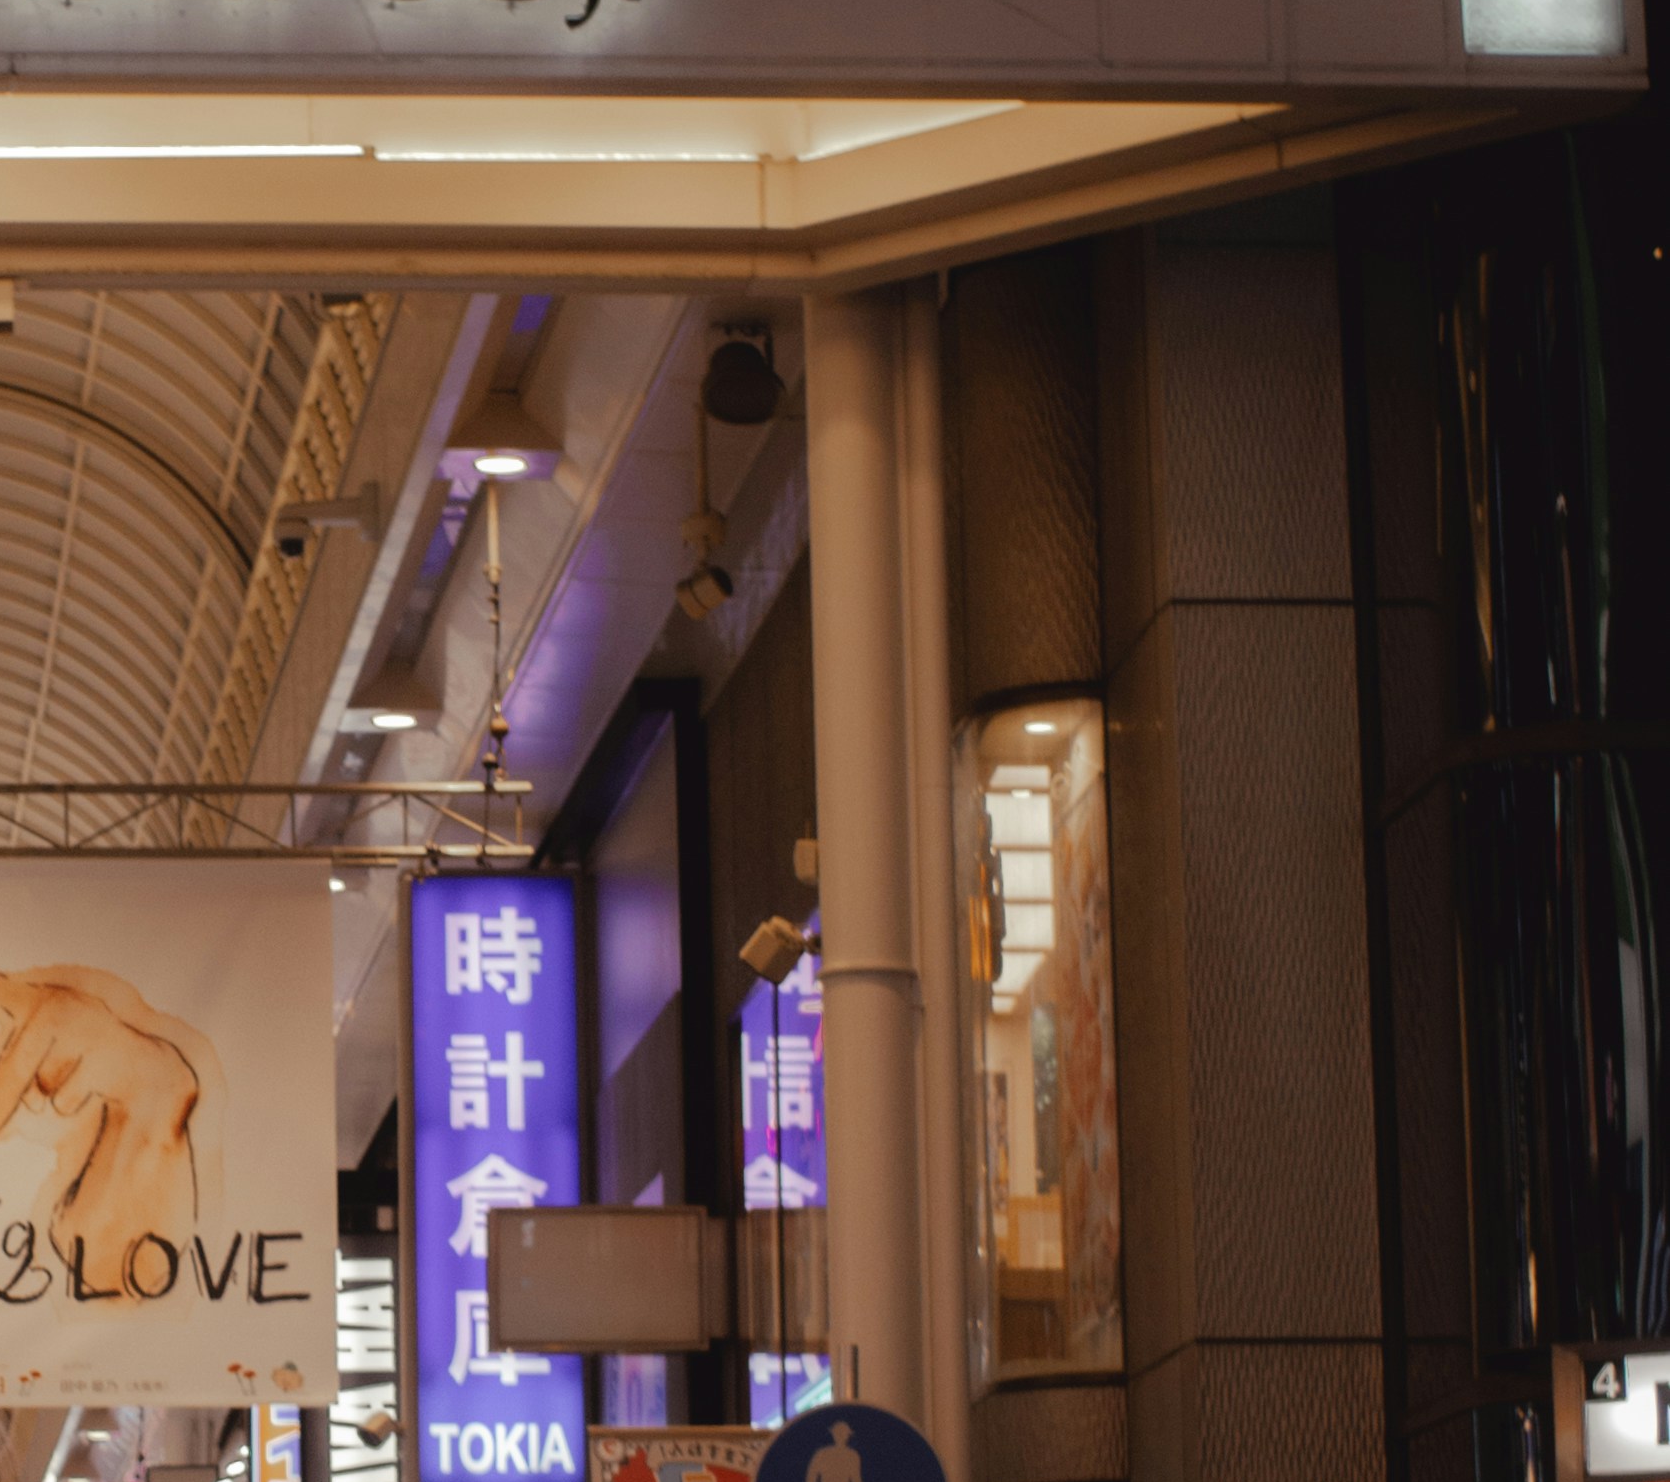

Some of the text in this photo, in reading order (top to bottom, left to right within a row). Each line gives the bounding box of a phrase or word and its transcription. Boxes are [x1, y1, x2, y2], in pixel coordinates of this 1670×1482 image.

[66, 1233, 311, 1305] LOVE
[336, 1248, 396, 1373] HAT
[1592, 1361, 1622, 1400] 4
[428, 1421, 577, 1475] TOKIA
